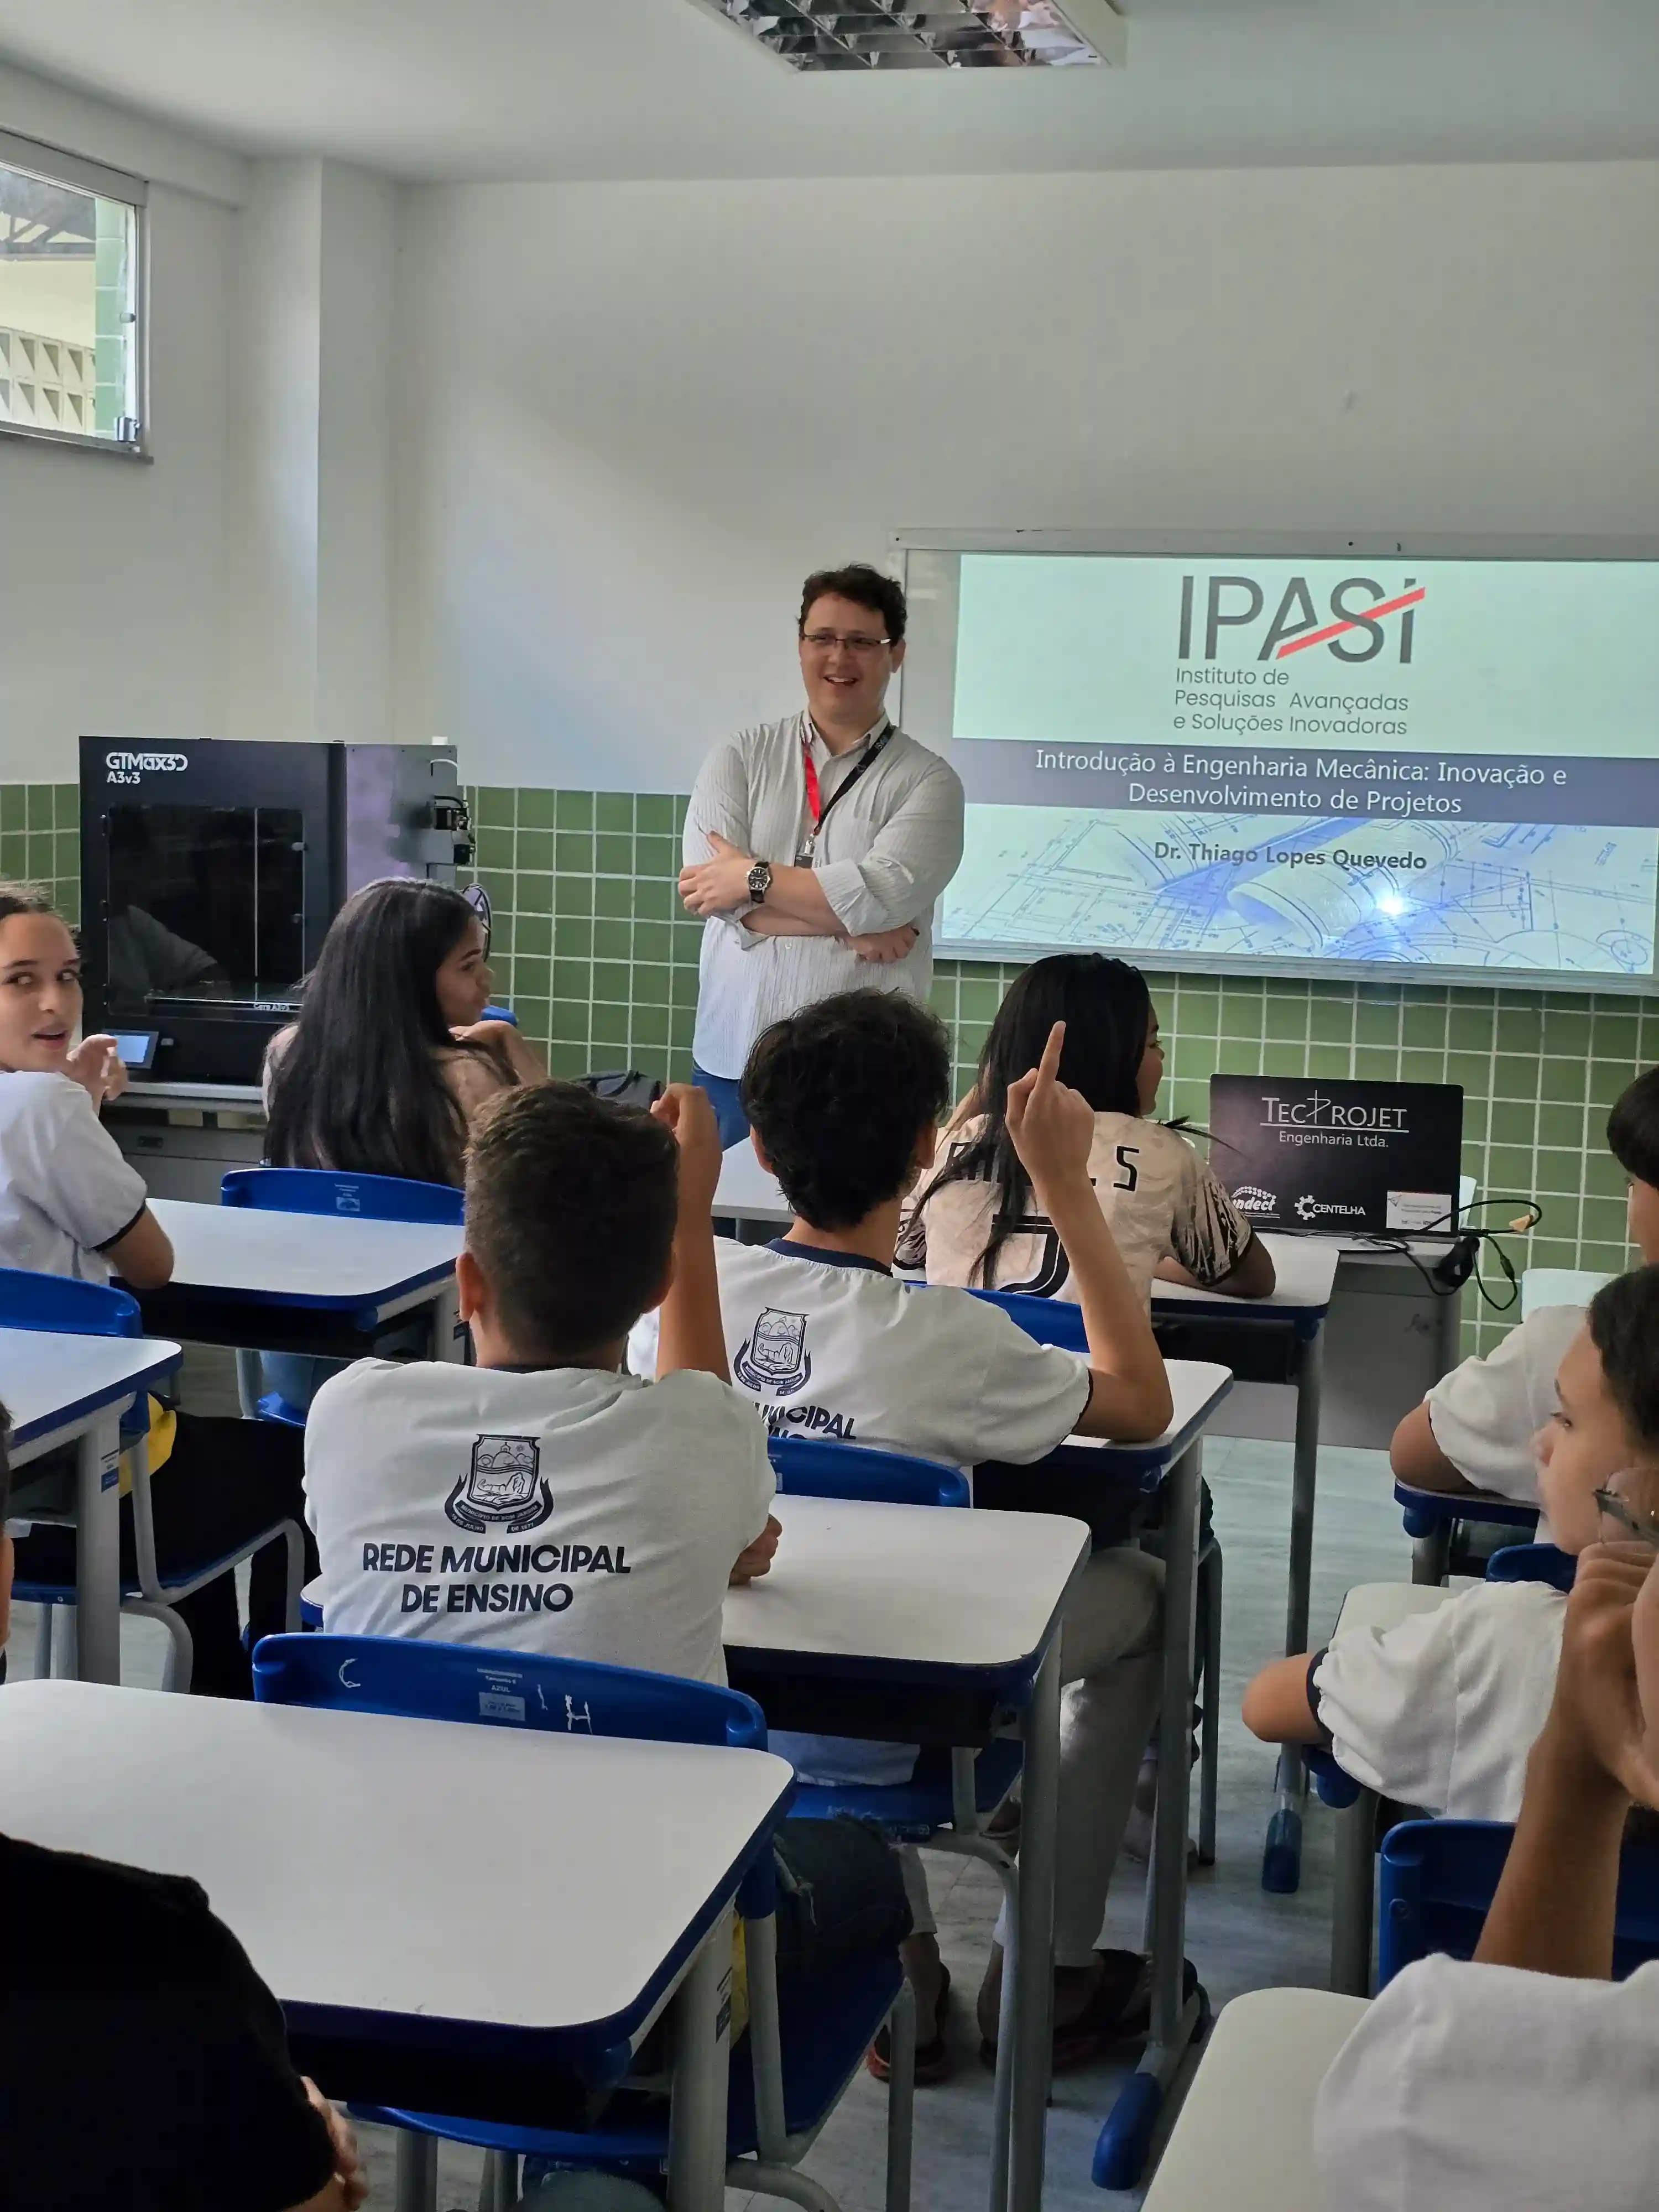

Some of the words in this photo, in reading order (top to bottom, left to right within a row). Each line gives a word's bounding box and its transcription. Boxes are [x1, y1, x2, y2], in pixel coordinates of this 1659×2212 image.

[1176, 667, 1256, 685] Instituto
[1263, 668, 1290, 686] de
[1175, 690, 1276, 711] Pesquisas
[1290, 692, 1408, 713] Avançadas
[1173, 716, 1186, 730] e
[1192, 713, 1283, 735] Soluções
[1290, 716, 1407, 735] Inovadoras
[107, 771, 140, 784] A3v3
[1036, 749, 1156, 776] Introdução
[1164, 753, 1176, 774] à
[1183, 754, 1307, 780] Engenharia
[1316, 758, 1429, 781] Mecânica:
[1437, 761, 1545, 789] Inovação
[1553, 769, 1567, 785] e
[1129, 783, 1322, 808] Desenvolvimento
[1330, 789, 1359, 810] de
[1367, 790, 1462, 817] Projetos
[1155, 842, 1181, 860] Dr.
[1189, 843, 1258, 866] Thiago
[1266, 847, 1326, 868] Lopes
[1332, 849, 1427, 871] Quevedo
[1279, 1131, 1353, 1146] Engenharia
[1358, 1135, 1389, 1147] Ltda.
[1312, 1204, 1366, 1215] CENTELHA
[363, 1542, 435, 1573] REDE
[440, 1545, 632, 1574] MUNICIPAL
[401, 1584, 440, 1613] DE
[447, 1583, 573, 1613] ENSINO
[491, 1684, 512, 1693] AZUL
